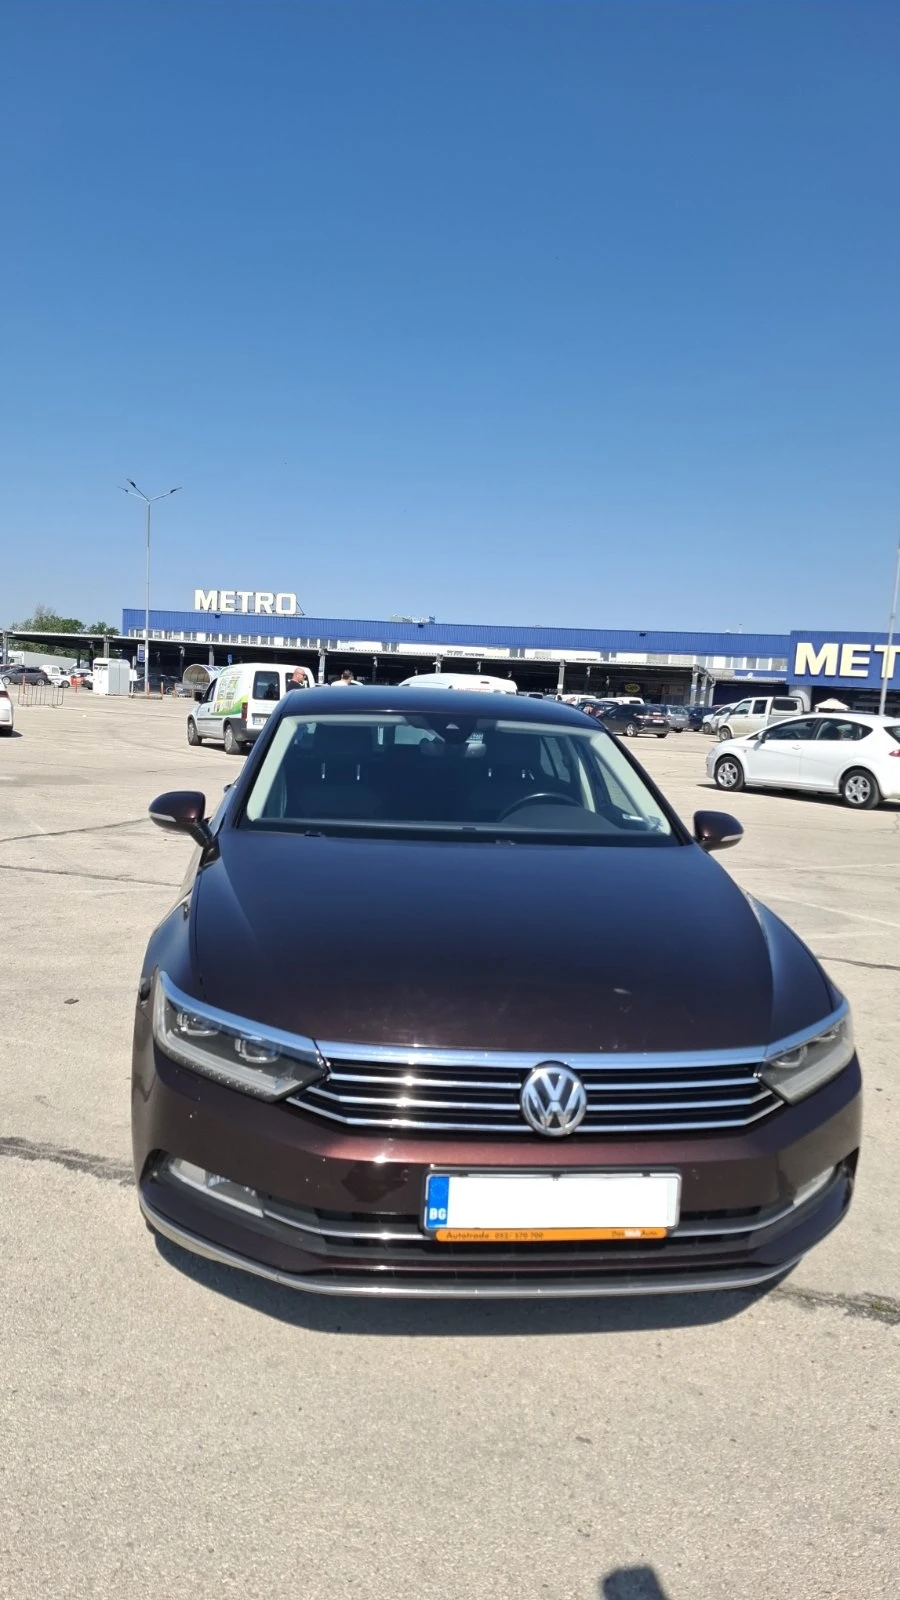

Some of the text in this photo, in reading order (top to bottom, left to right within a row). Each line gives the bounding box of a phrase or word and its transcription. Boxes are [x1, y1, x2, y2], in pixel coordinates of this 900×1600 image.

[194, 589, 297, 615] METRO
[794, 642, 900, 678] MET
[429, 1207, 447, 1221] BG
[446, 1230, 487, 1240] Autotrade
